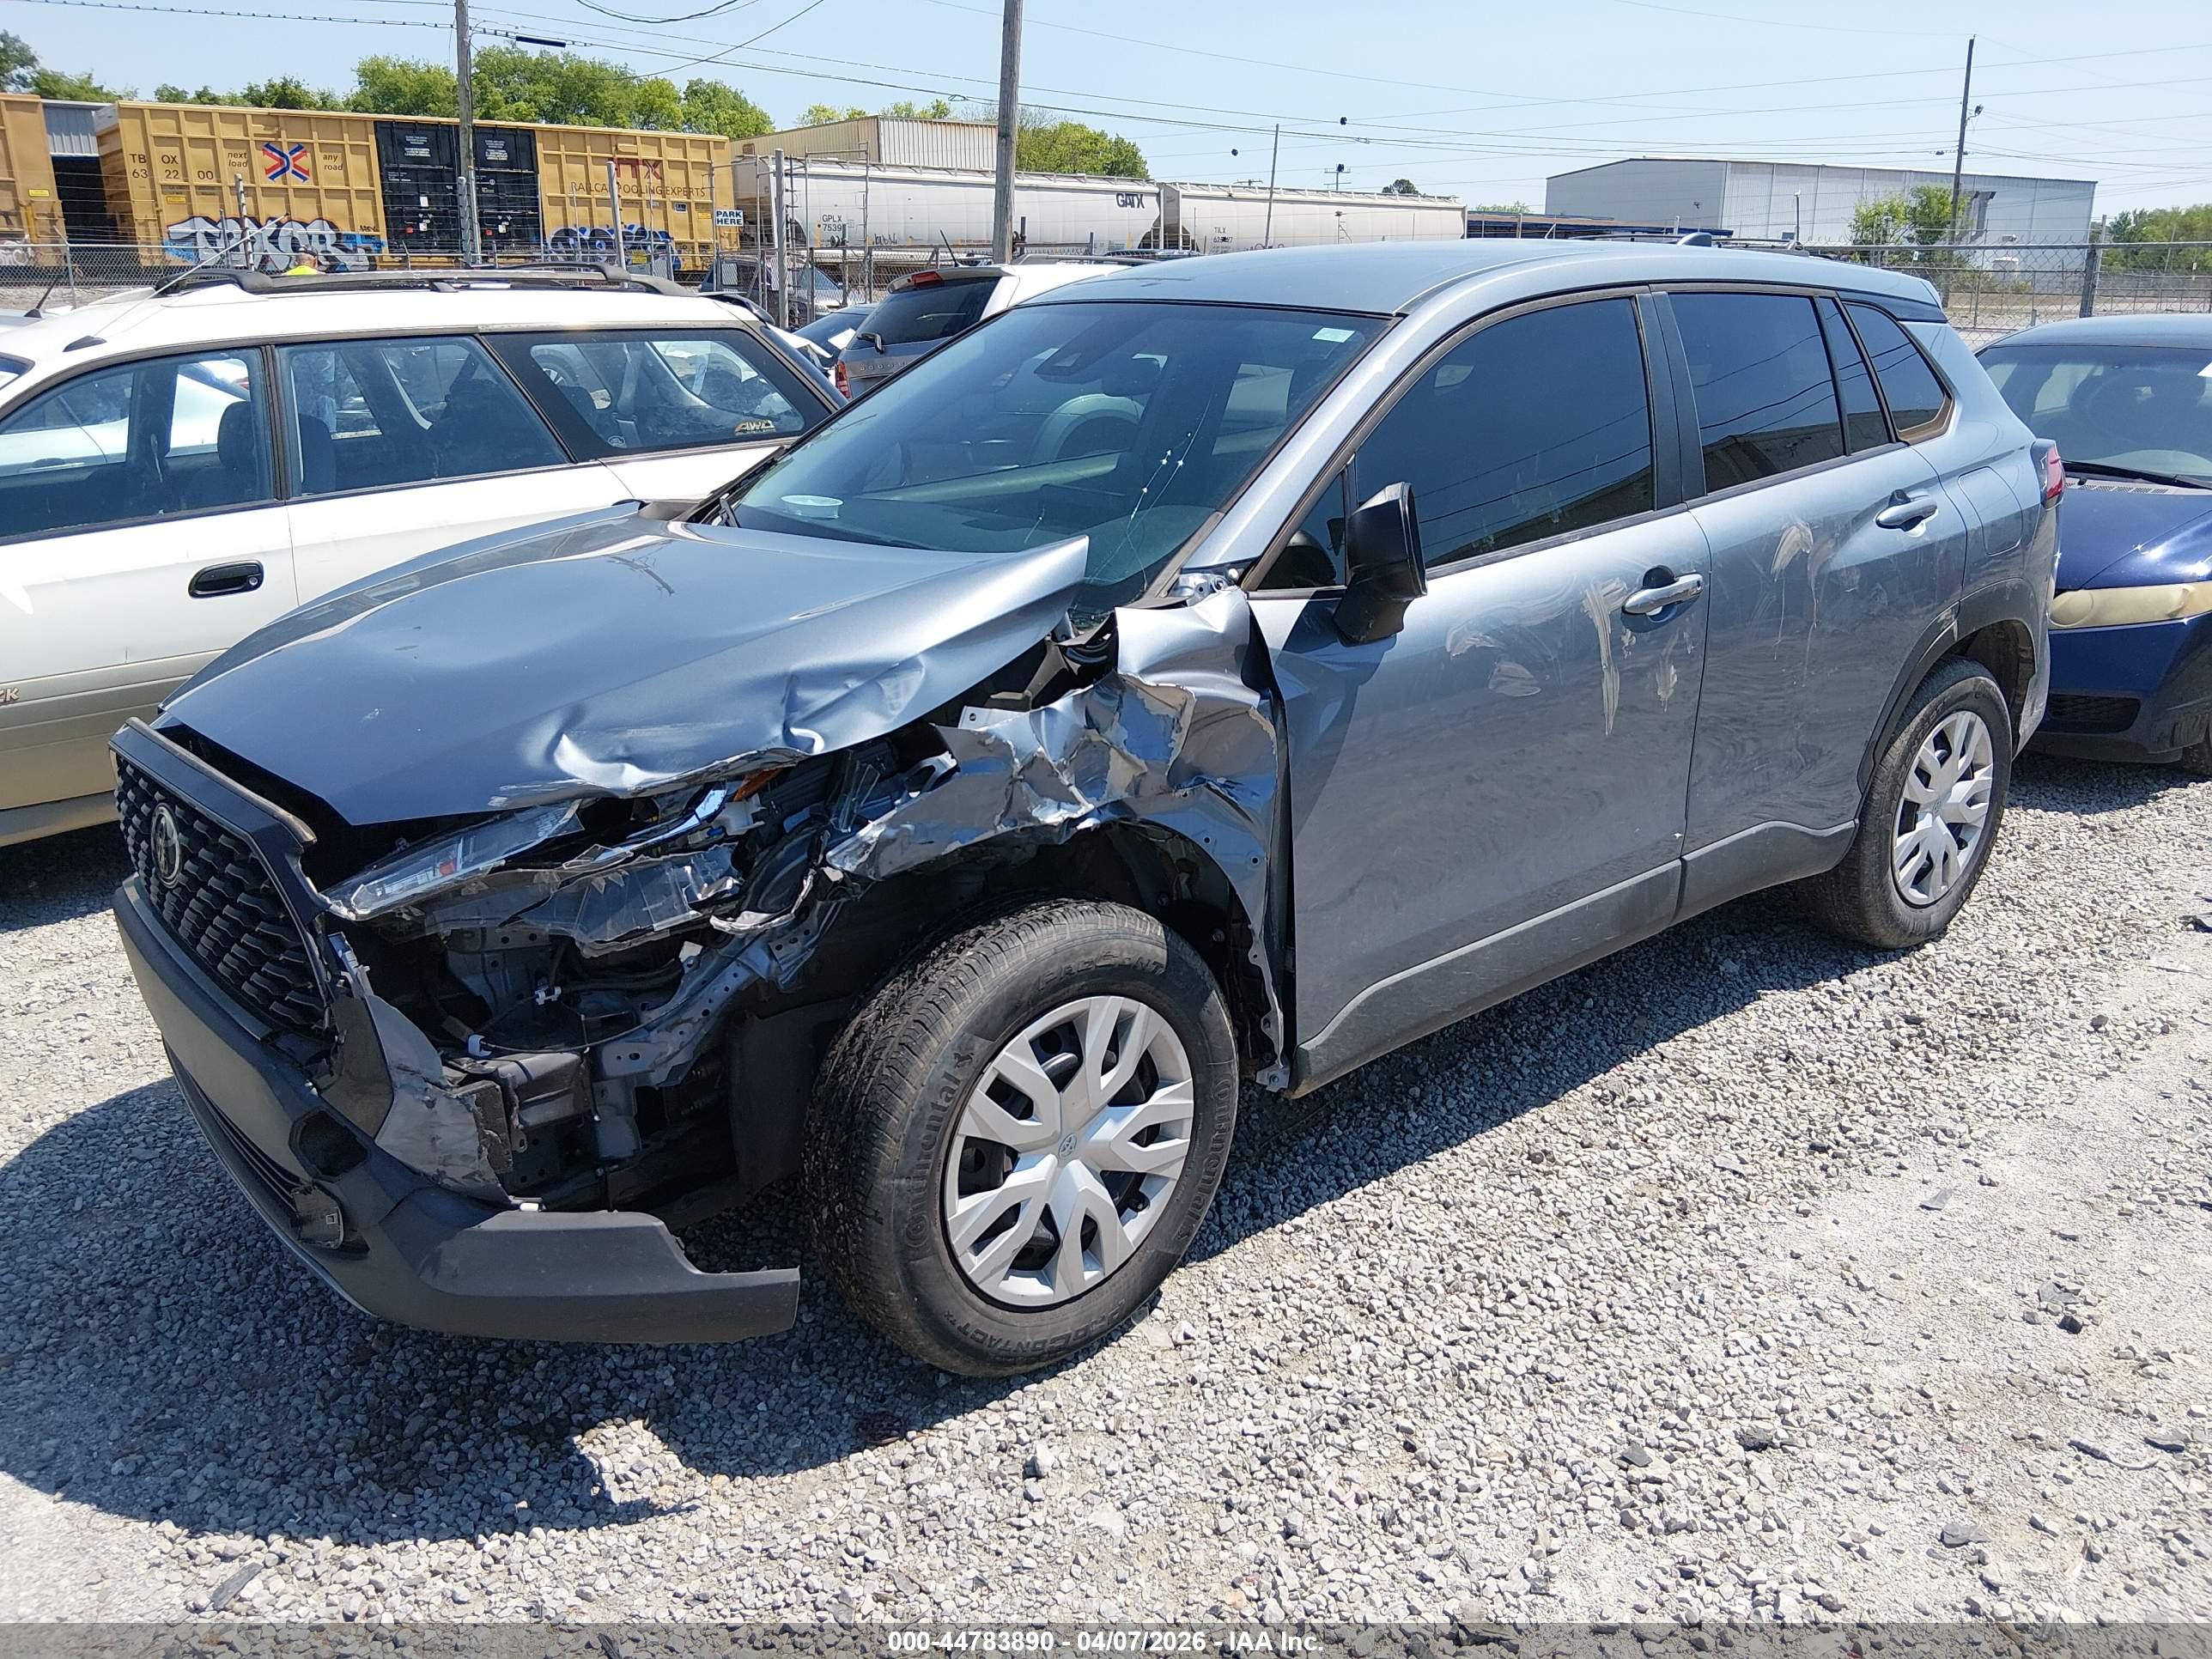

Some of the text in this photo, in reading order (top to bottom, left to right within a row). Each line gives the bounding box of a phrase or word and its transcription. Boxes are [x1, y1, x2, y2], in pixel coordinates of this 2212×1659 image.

[129, 154, 179, 165] TB OX
[131, 168, 214, 179] 63 22 00
[570, 181, 706, 198] RAILCA POOLING EXPERTS
[1116, 193, 1146, 209] GATX
